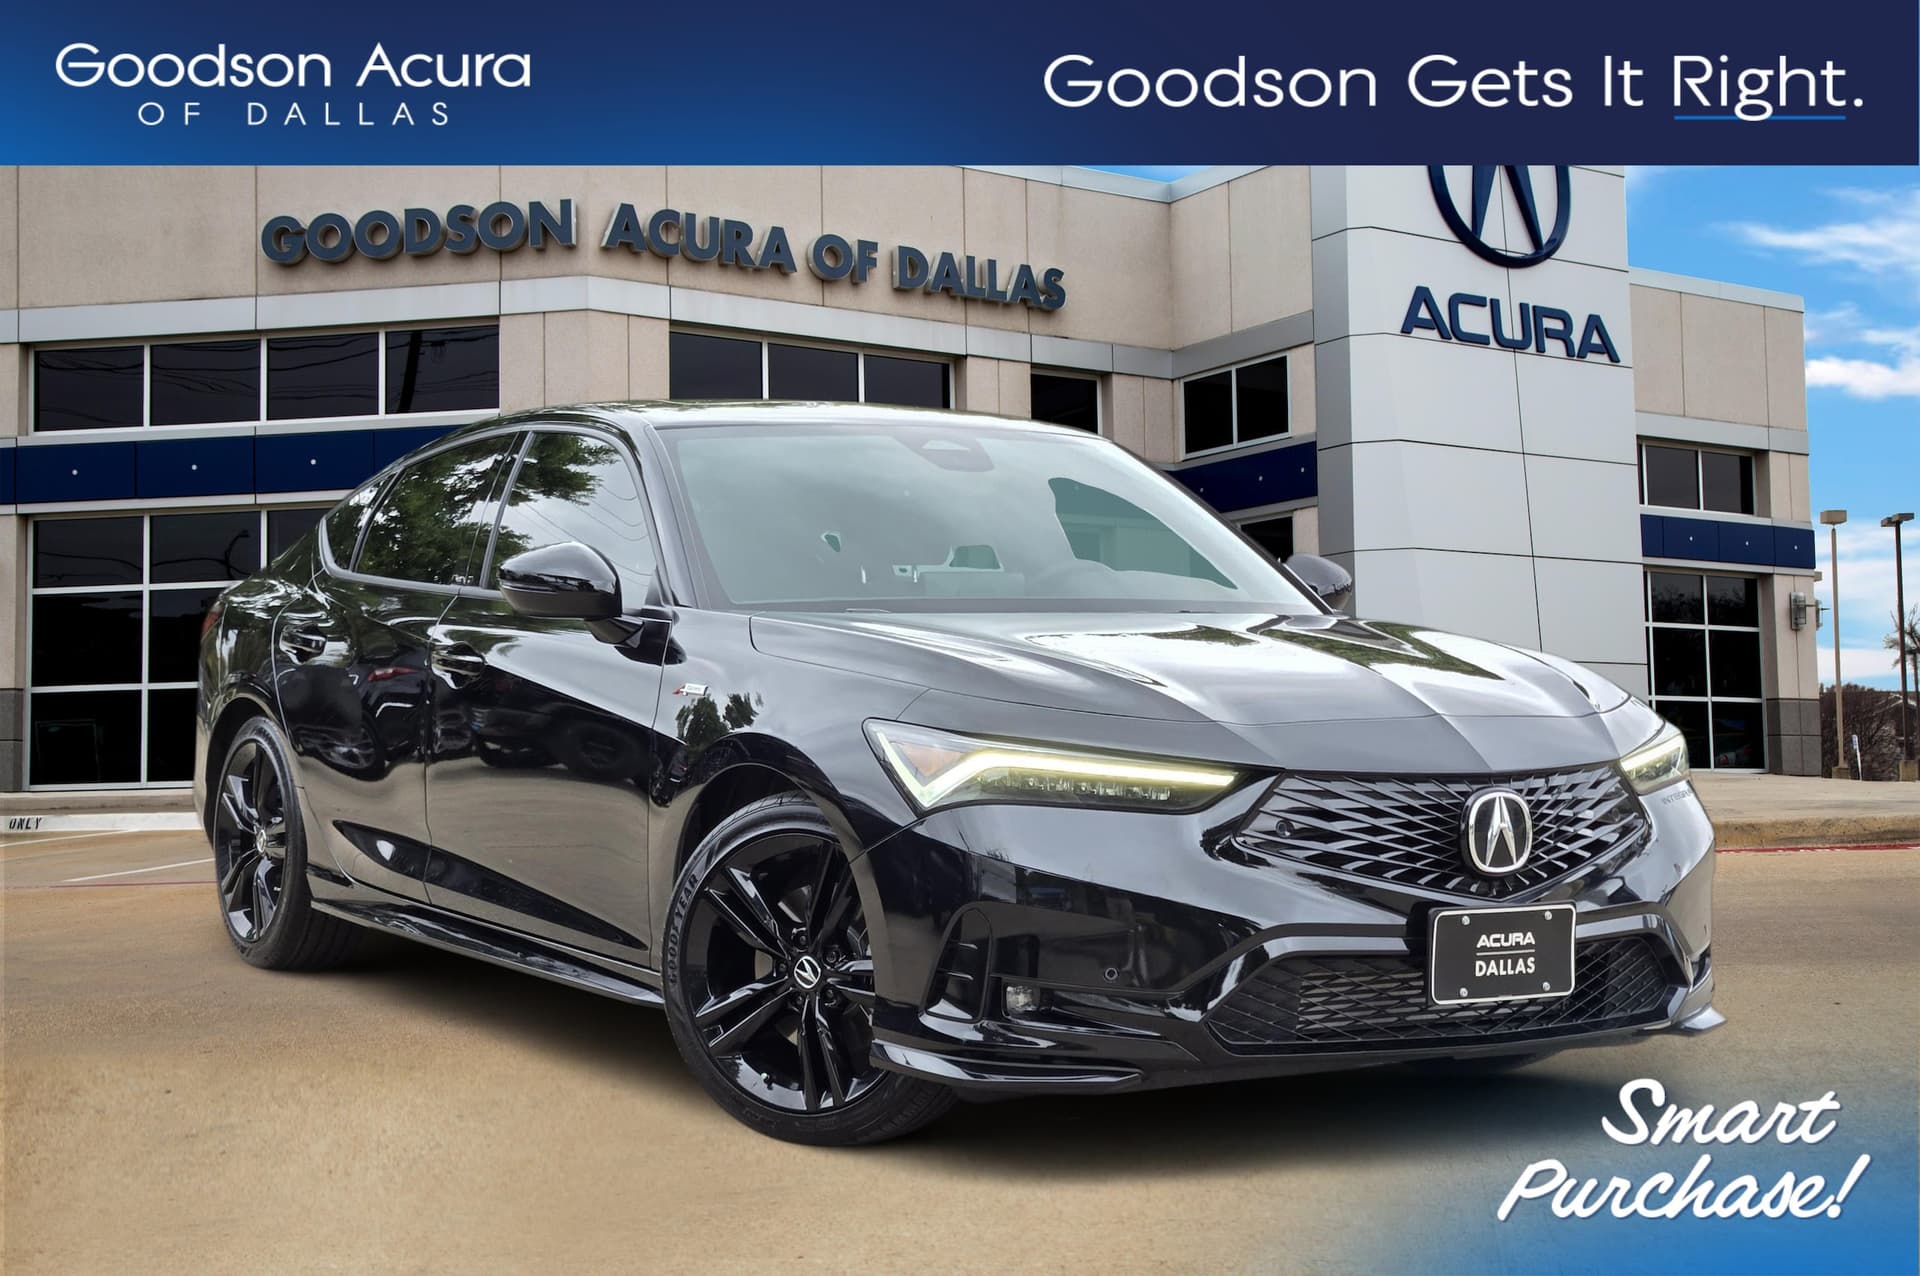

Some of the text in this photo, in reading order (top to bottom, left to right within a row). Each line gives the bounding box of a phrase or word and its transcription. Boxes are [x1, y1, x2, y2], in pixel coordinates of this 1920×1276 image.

[261, 198, 1067, 312] GOODSON ACURA OF DALLAS
[1400, 285, 1621, 363] ACURA
[9, 817, 41, 830] ONLY
[1476, 931, 1536, 948] ACURA
[1475, 956, 1536, 977] DALLAS
